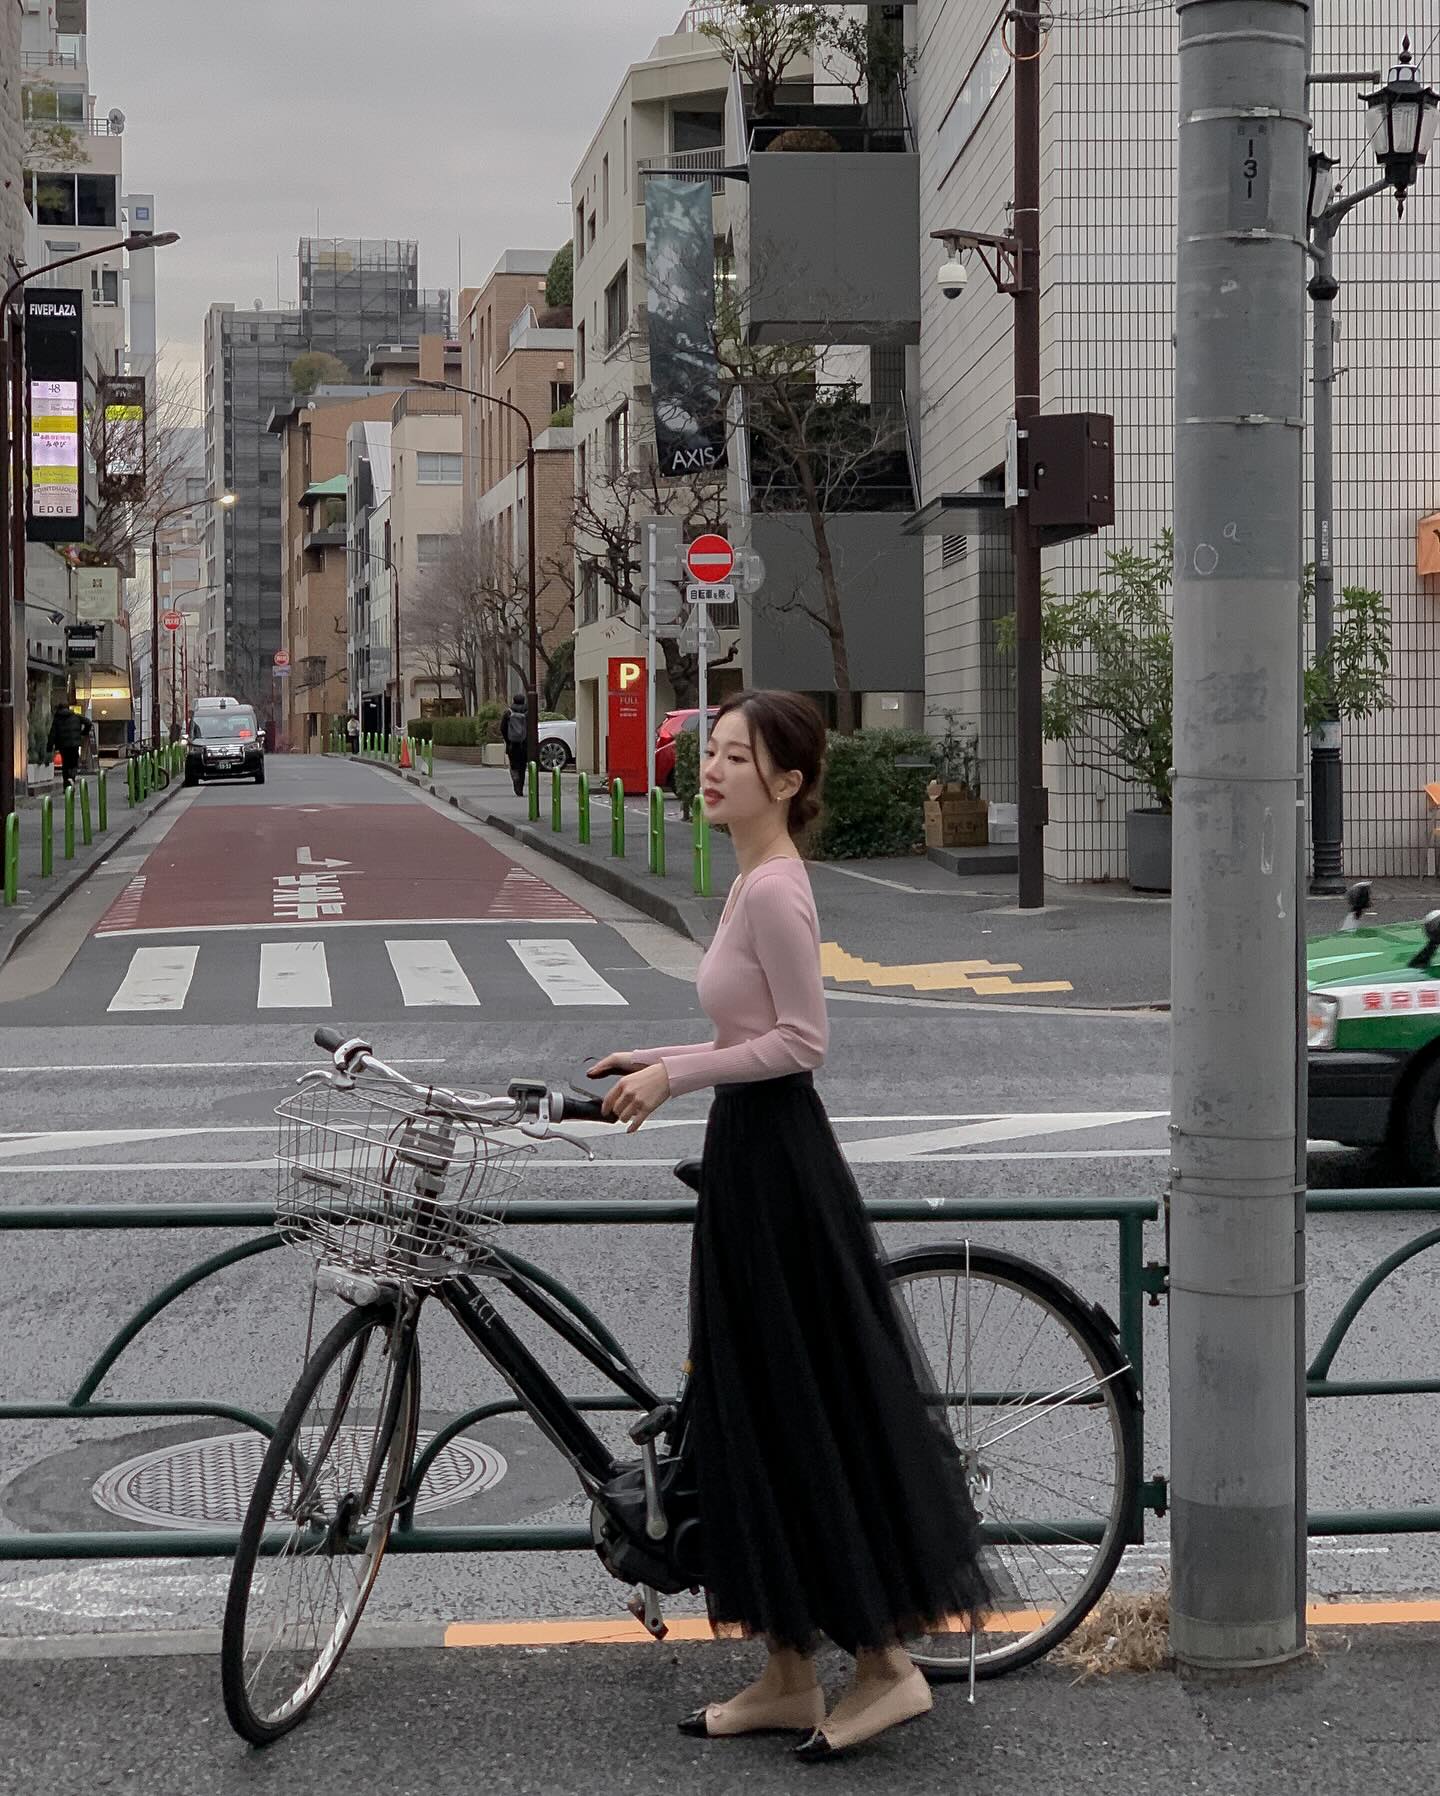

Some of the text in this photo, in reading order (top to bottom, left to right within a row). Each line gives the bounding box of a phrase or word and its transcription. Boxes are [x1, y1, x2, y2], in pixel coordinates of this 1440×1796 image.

[29, 303, 77, 316] FIVEPLAZA
[671, 447, 717, 471] AXIS
[39, 505, 73, 514] EDGE
[690, 589, 731, 601] 自転車を除く
[620, 663, 641, 689] P
